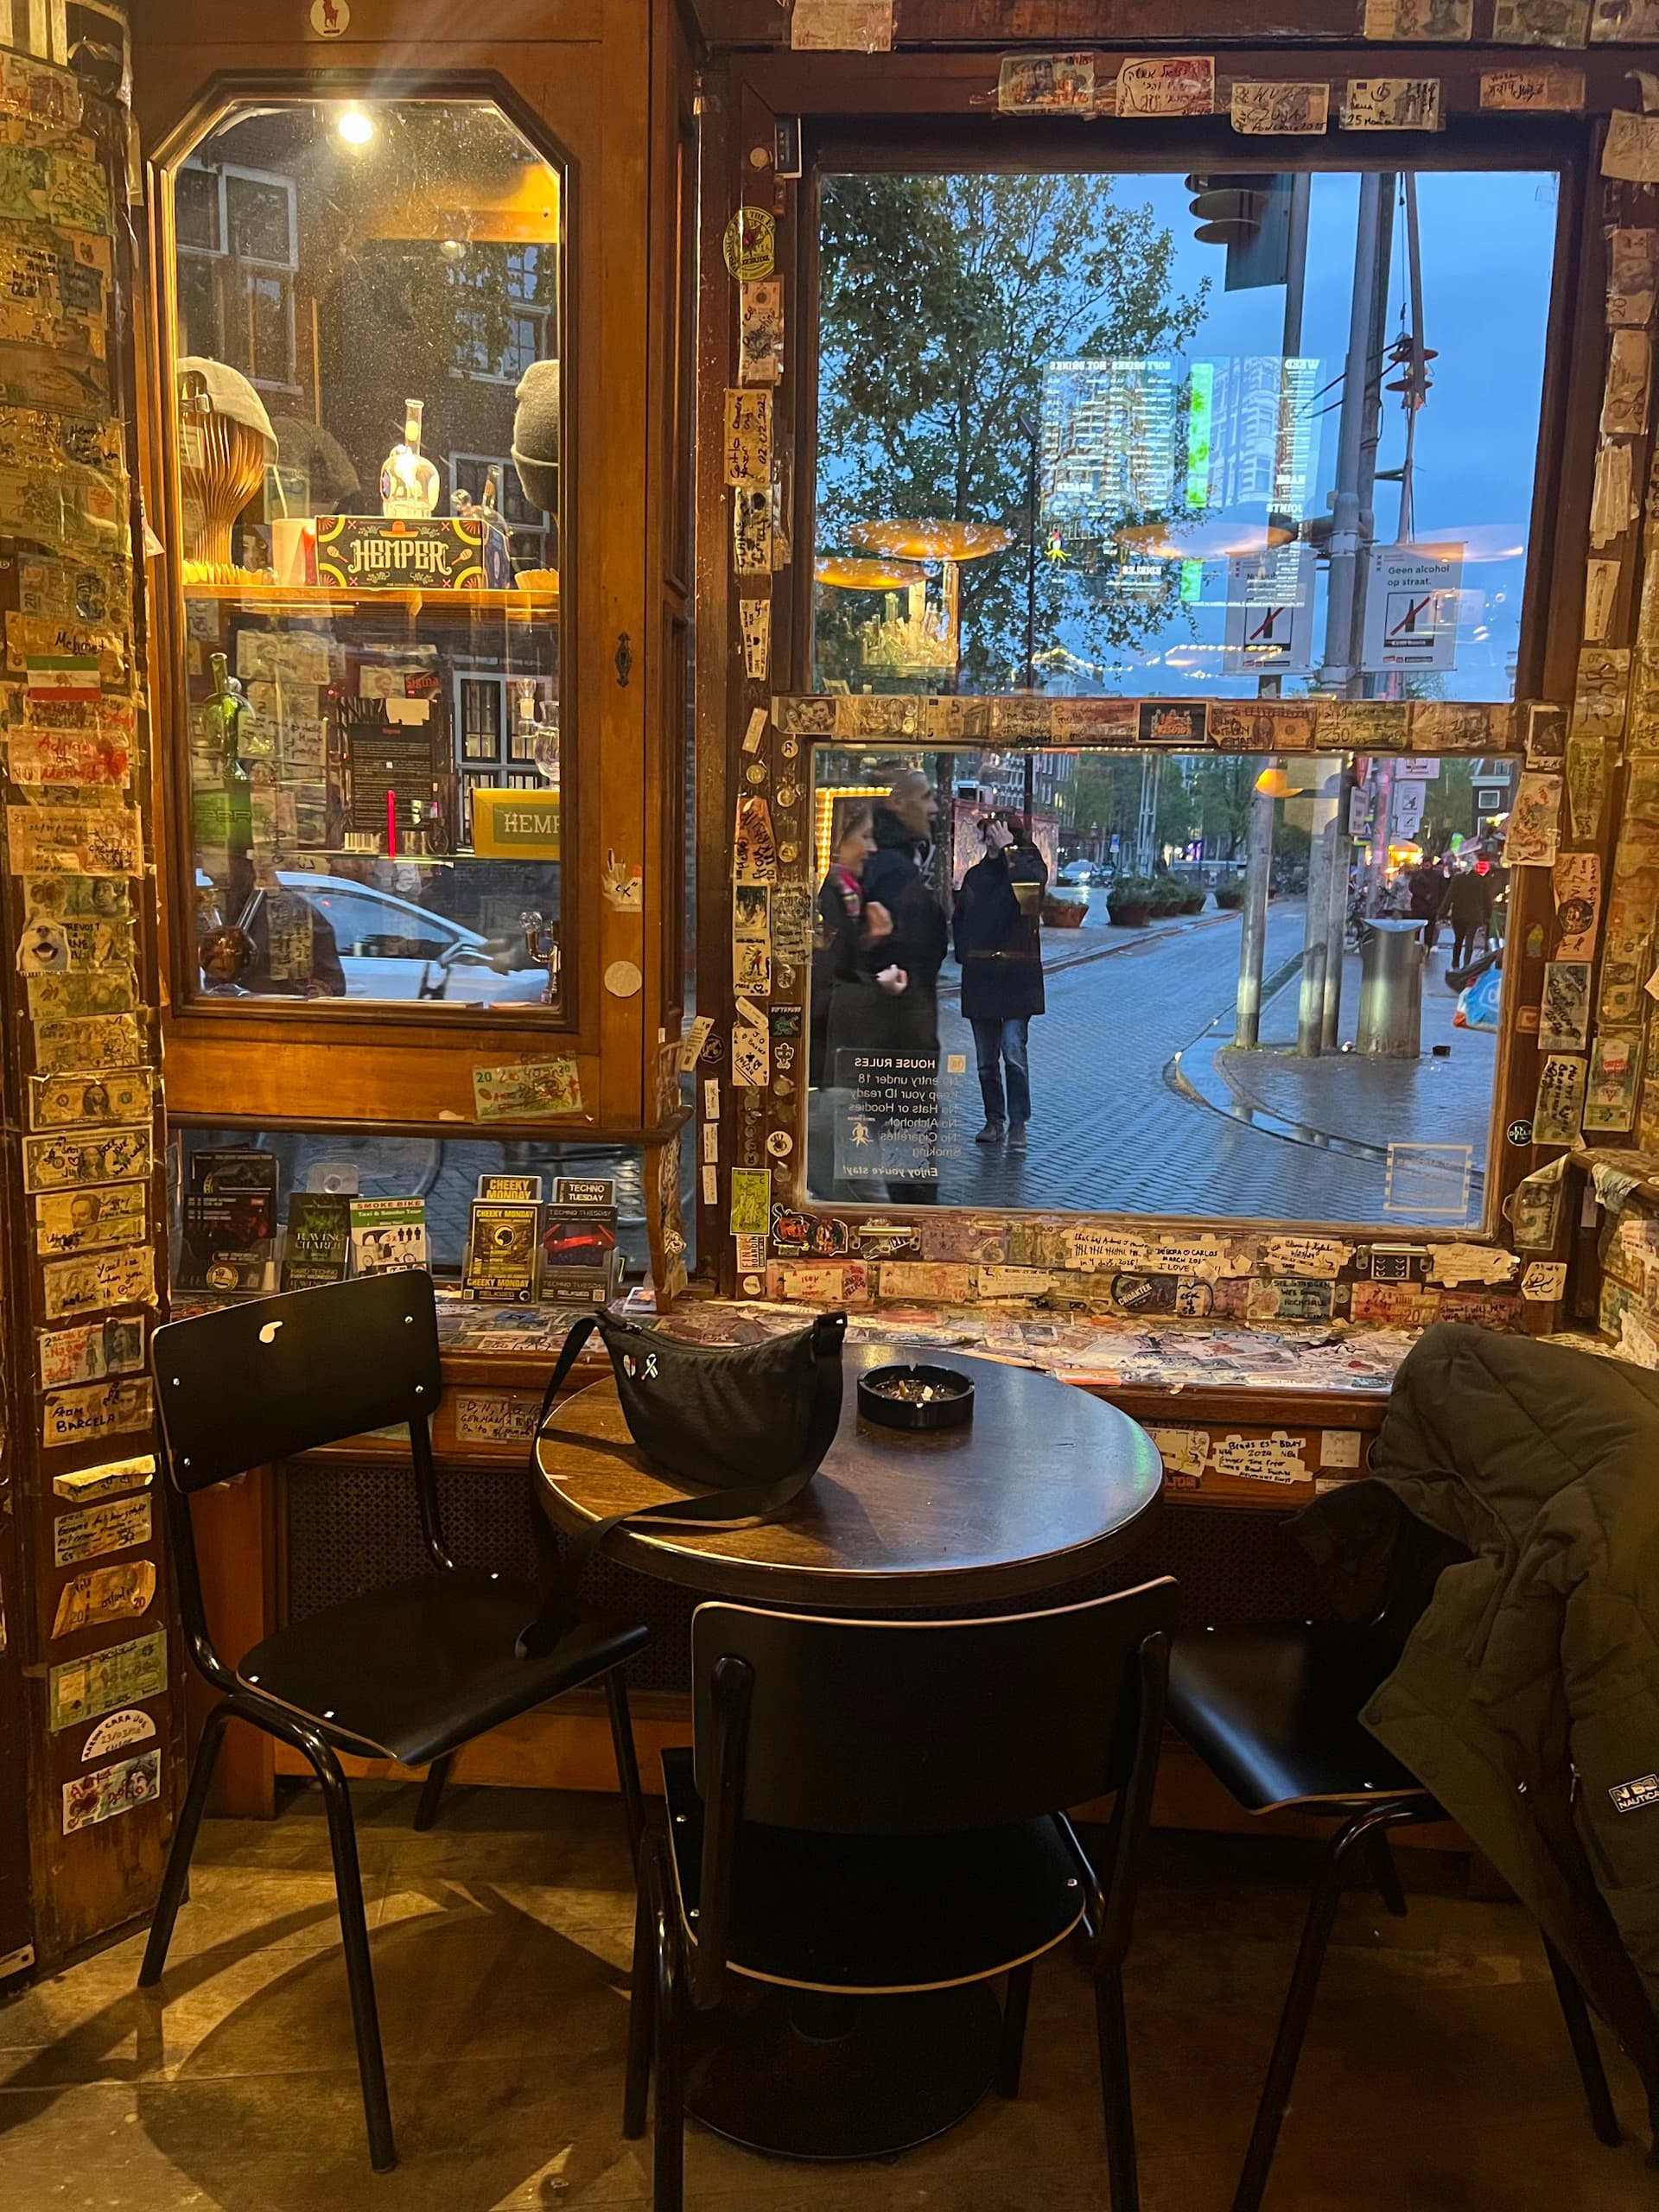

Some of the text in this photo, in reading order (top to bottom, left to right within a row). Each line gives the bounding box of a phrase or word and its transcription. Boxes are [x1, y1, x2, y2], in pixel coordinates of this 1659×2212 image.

[348, 539, 452, 575] HEMPER
[1389, 565, 1450, 575] Geen alcohol
[1388, 578, 1401, 588] op
[489, 1179, 530, 1189] CHEEKY
[569, 1184, 605, 1192] TECHNO
[486, 1189, 531, 1199] MONDAY
[476, 1210, 534, 1218] CHEEKY MONDAY
[467, 1278, 531, 1287] CHEEKY MONDAY
